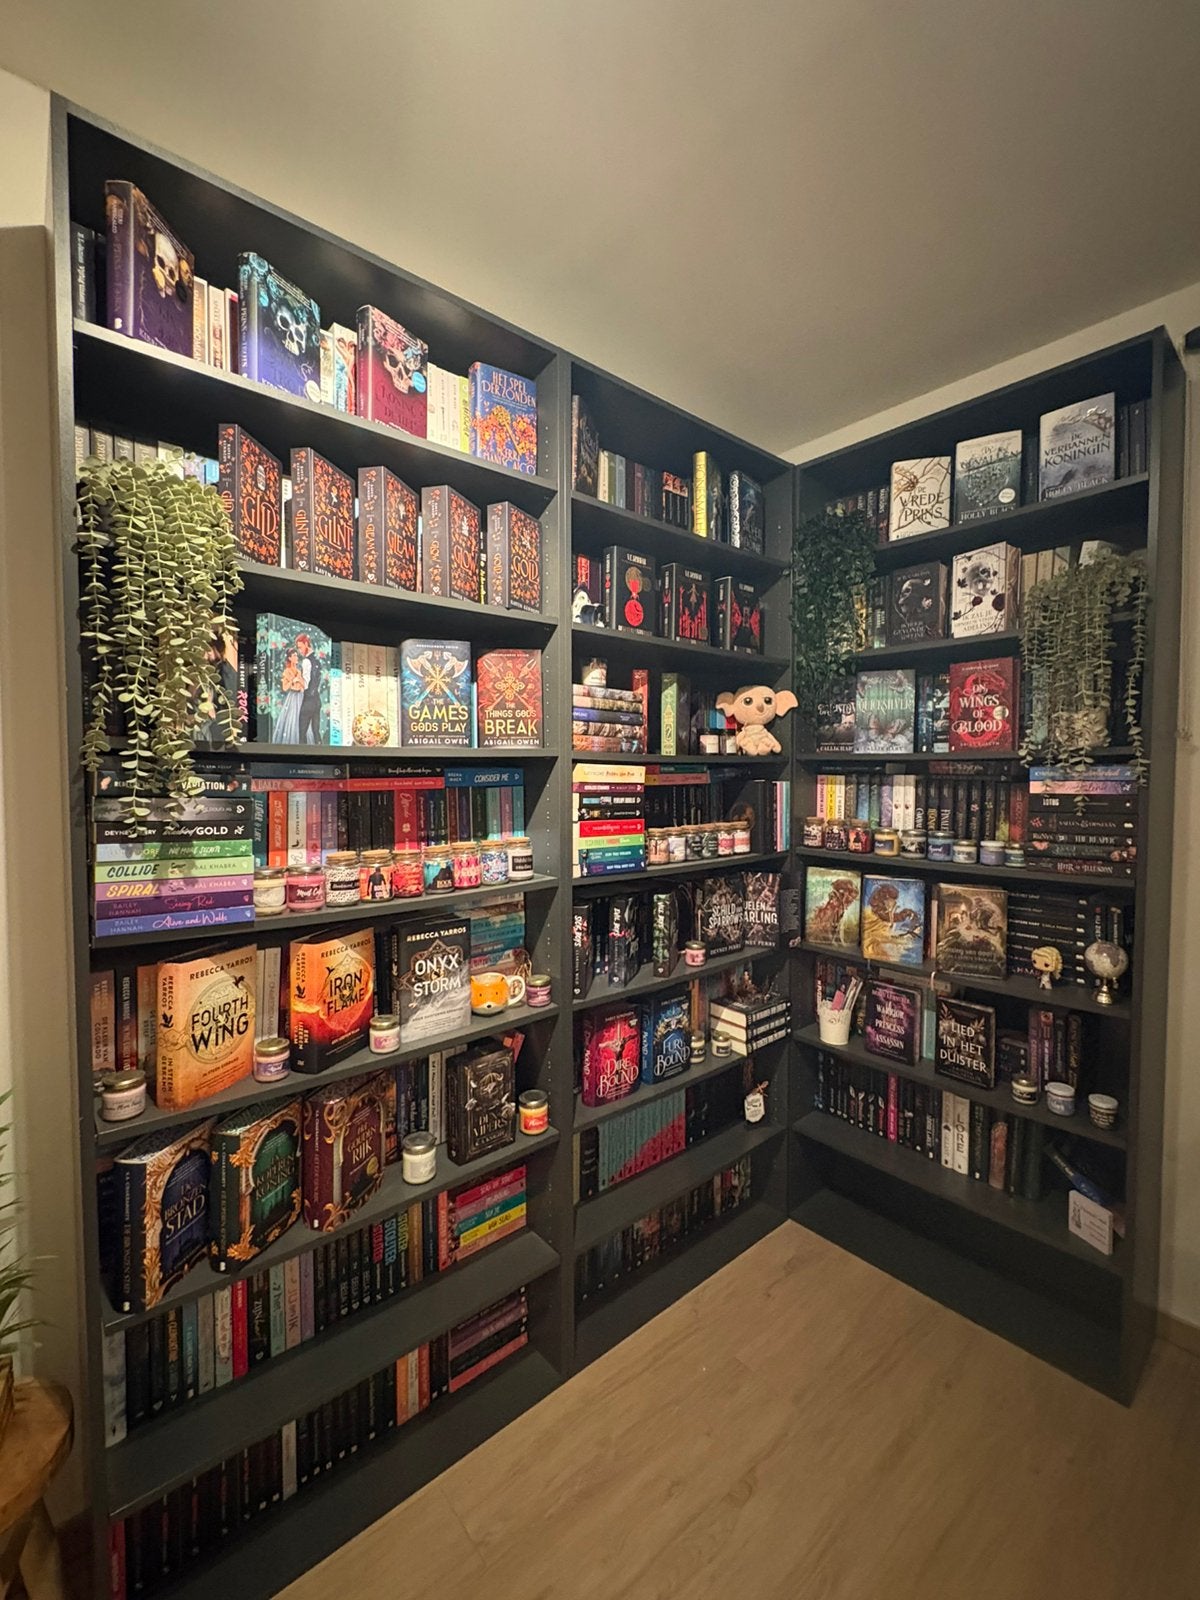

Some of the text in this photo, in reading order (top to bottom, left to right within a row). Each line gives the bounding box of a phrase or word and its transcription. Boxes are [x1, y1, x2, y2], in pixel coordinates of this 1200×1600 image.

[492, 371, 527, 393] HET SPEL
[482, 380, 536, 408] DER ZONDEN
[1044, 431, 1111, 456] VERBANNEN
[1044, 441, 1111, 469] KONINGIN
[900, 492, 945, 507] WREDE
[243, 494, 277, 544] GILD
[295, 509, 309, 535] GLINT
[904, 507, 943, 522] PRINS
[960, 509, 986, 521] HOLLY
[318, 515, 354, 551] GLINT
[387, 529, 416, 563] GLEAM
[513, 555, 540, 585] GOLD
[959, 694, 1000, 708] WINGS
[963, 683, 988, 697] ON
[238, 690, 249, 723] ROCK
[408, 704, 469, 722] GAMES
[484, 709, 537, 719] THINGS GODS
[857, 699, 913, 715] QUICKSILVER
[972, 708, 984, 718] OF
[410, 722, 467, 733] GODS PLAY
[484, 719, 538, 736] BREAK
[951, 719, 1002, 735] BLOOD
[474, 773, 510, 783] CONSIDER ME
[196, 826, 228, 836] GOLD
[107, 863, 160, 878] COLLIDE
[1057, 862, 1075, 872] HEIR
[106, 880, 237, 898] SPIRAL KHABRA
[108, 908, 142, 916] HANNAH
[708, 912, 743, 929] SPARROWS
[712, 903, 736, 919] SCHILD
[110, 925, 144, 934] HANNAH
[407, 926, 467, 943] REBECCA YARROS
[573, 915, 582, 948] SICK BOYS
[320, 938, 371, 959] REBECCA YARROS
[189, 955, 254, 981] REBECCA YARROS
[414, 953, 459, 976] ONYX
[122, 976, 130, 1000] REBECCA
[329, 968, 363, 997] IRON
[413, 976, 462, 998] STORM
[191, 994, 249, 1032] FOURTH
[327, 987, 365, 1017] FLAME
[191, 1012, 249, 1054] WING
[951, 1018, 975, 1037] LIED
[942, 1034, 984, 1056] IN HET
[653, 1045, 691, 1077] BOUND
[940, 1048, 987, 1074] DUISTER
[596, 1065, 639, 1098] BOUND
[955, 1113, 965, 1154] LORE
[352, 1137, 373, 1165] RIJK
[165, 1194, 205, 1240] STAD
[384, 1218, 397, 1266] STOUTER
